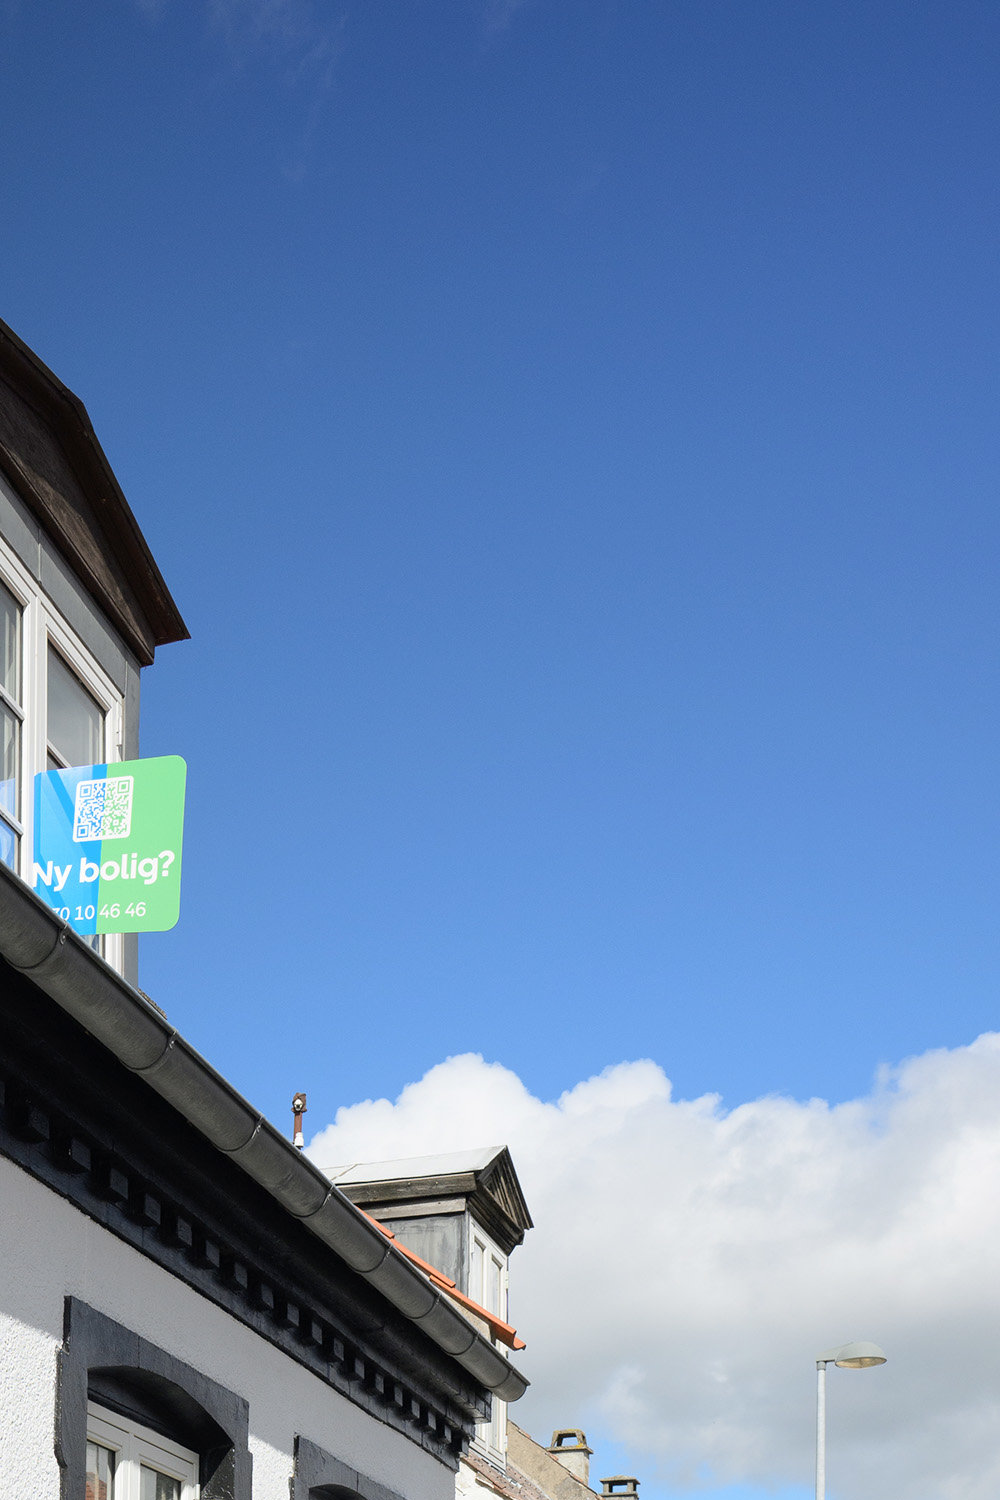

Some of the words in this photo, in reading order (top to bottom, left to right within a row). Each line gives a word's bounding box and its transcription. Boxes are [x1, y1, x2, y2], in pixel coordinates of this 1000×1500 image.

[32, 860, 72, 892] Ny
[79, 850, 175, 885] bolig?
[75, 904, 95, 921] 10
[99, 903, 120, 918] 46
[125, 901, 146, 917] 46
